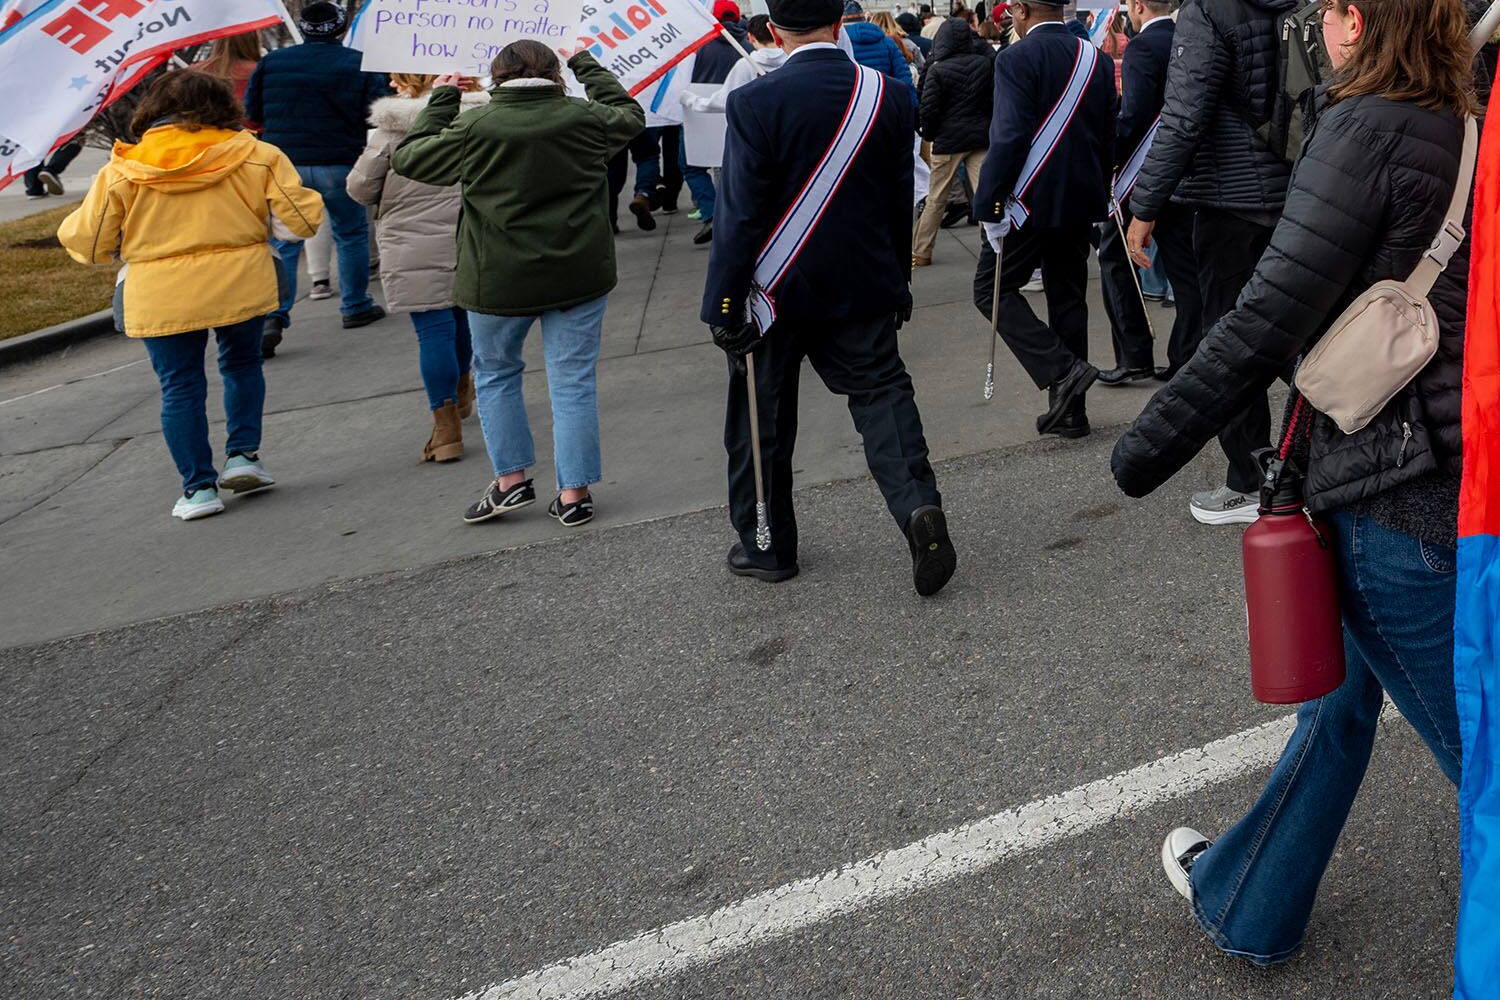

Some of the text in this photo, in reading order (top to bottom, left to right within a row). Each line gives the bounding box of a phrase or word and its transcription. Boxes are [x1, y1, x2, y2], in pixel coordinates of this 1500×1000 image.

[375, 9, 570, 37] person no matter
[411, 32, 459, 58] how
[1223, 495, 1247, 510] HOKA
